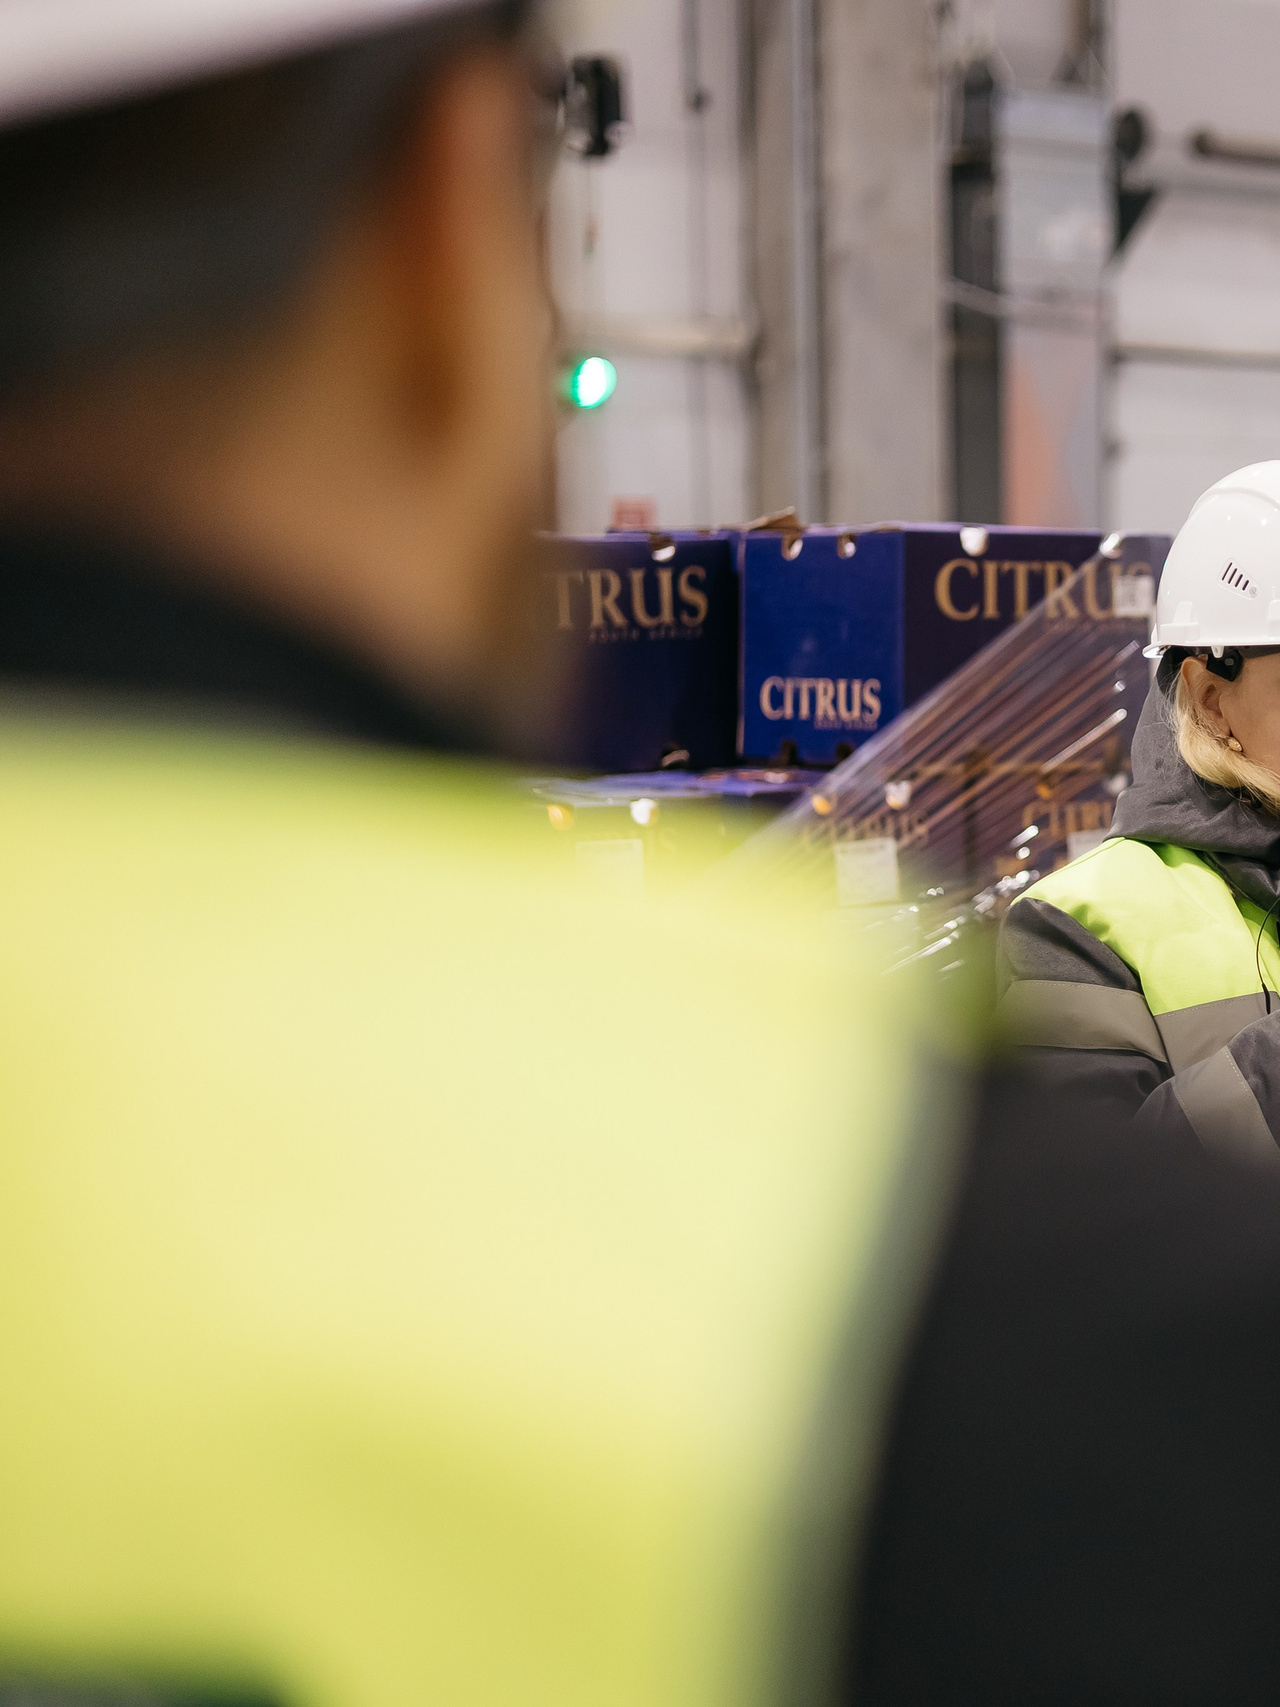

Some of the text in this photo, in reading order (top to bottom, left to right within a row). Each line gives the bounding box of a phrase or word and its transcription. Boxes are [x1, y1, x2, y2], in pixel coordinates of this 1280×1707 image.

[552, 564, 709, 631] TRUS
[934, 557, 1153, 623] CITRU
[759, 675, 883, 723] CITRUS
